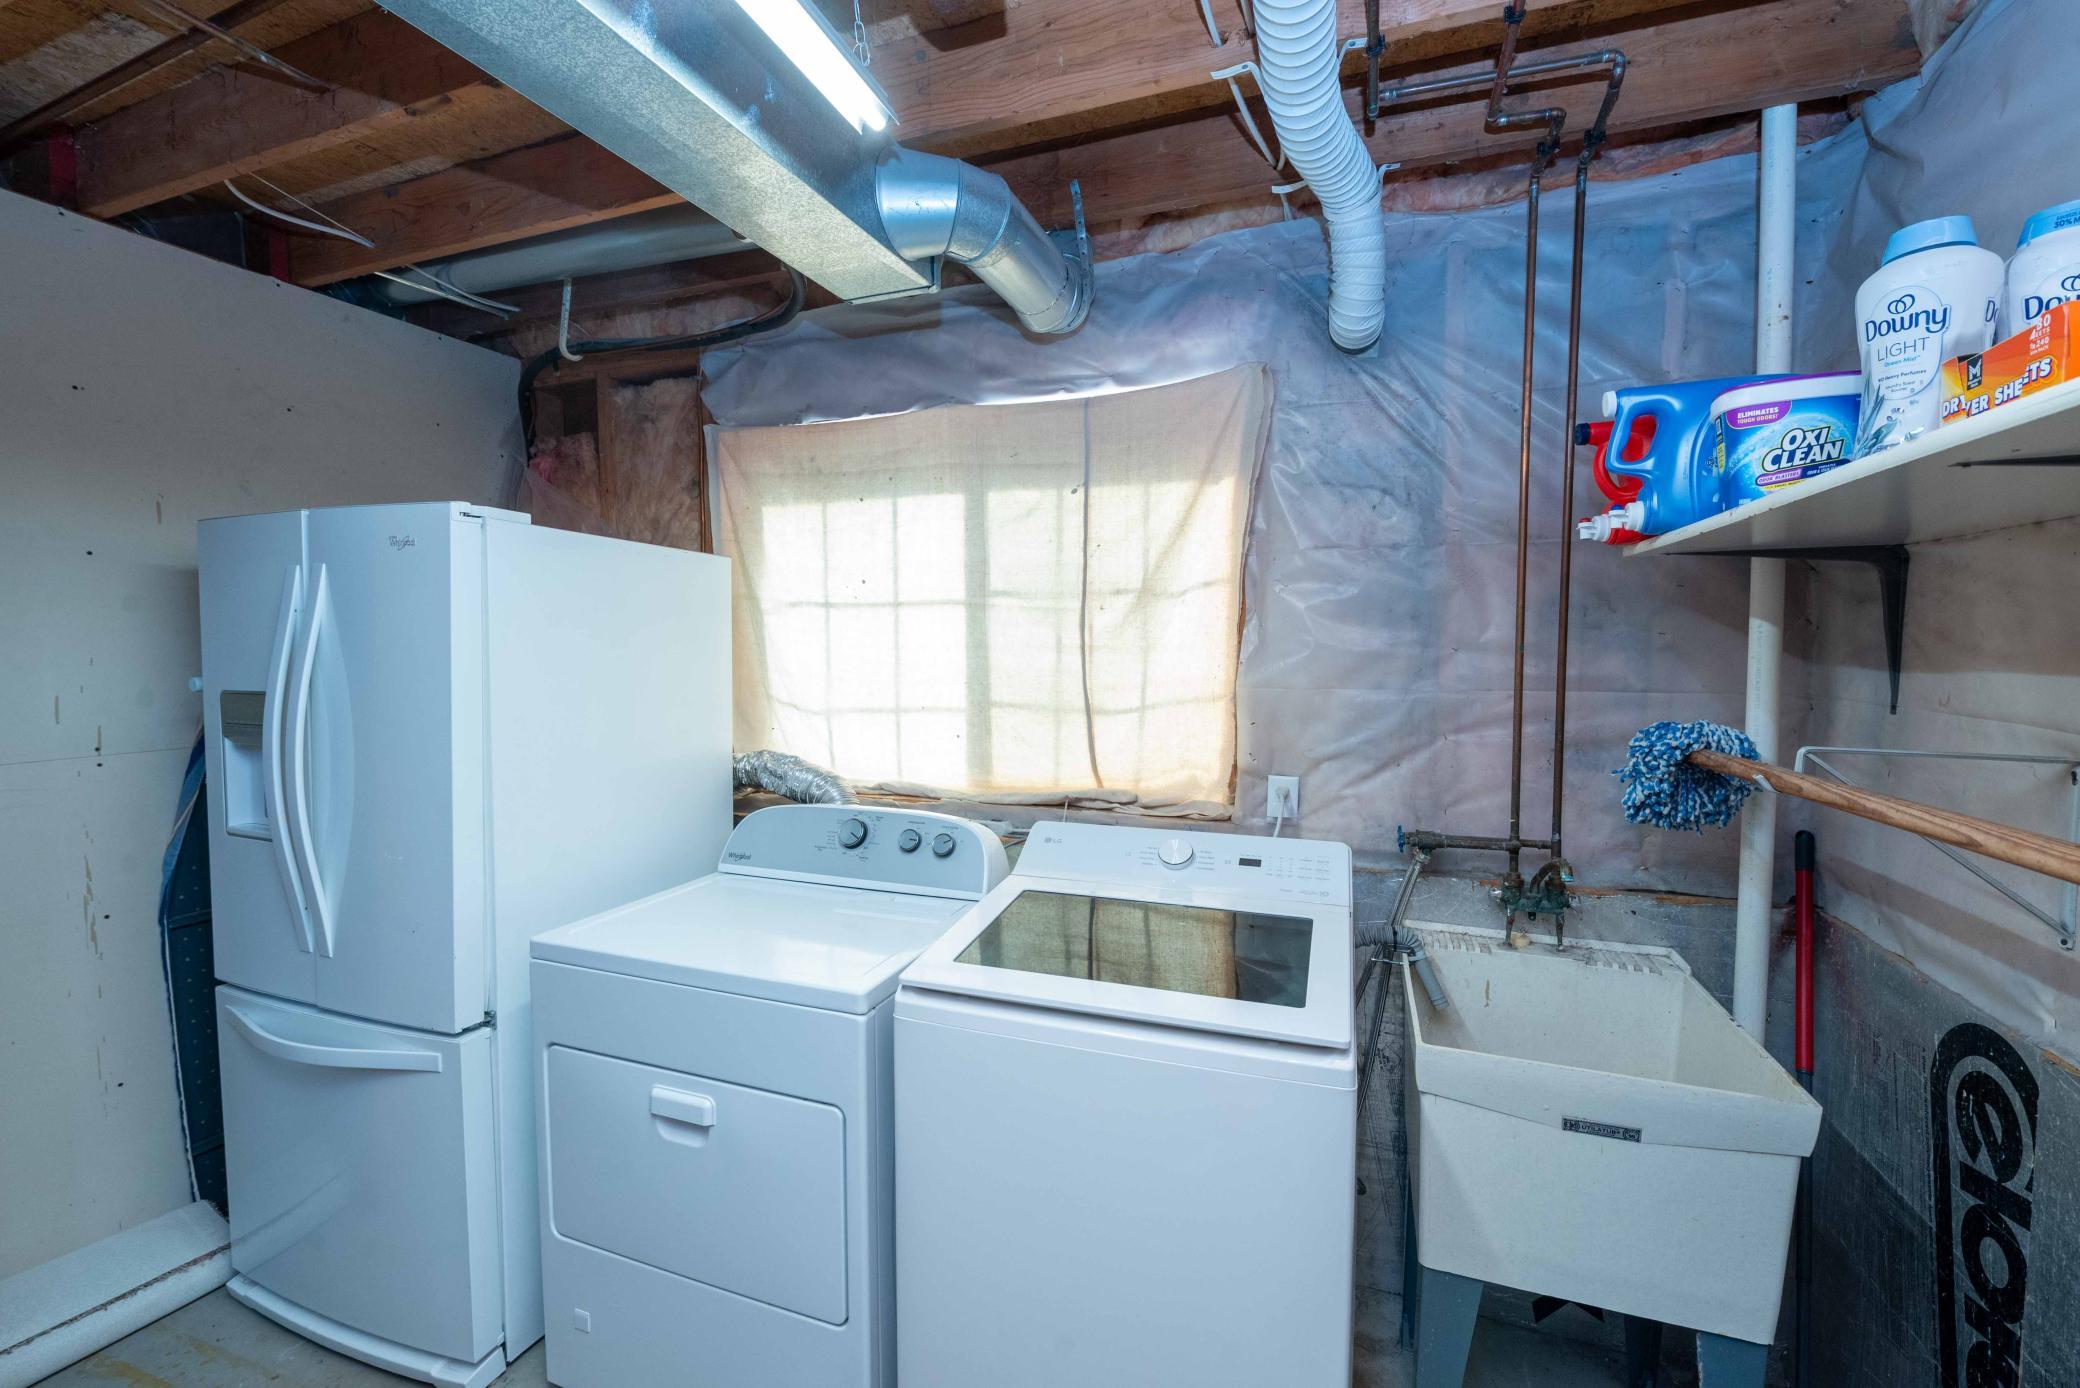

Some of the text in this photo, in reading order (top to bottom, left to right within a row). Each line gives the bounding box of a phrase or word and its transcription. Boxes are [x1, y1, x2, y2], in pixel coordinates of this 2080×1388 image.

[1865, 306, 1948, 342] Downy
[1877, 336, 1930, 361] LIGHT
[1900, 369, 1927, 377] Perfumes
[1994, 357, 2053, 406] SHEETS
[1737, 406, 1779, 419] ELIMINATES
[1756, 413, 1778, 422] ODORS!
[1781, 426, 1830, 450] OXI
[1762, 439, 1844, 472] CLEAN
[1759, 476, 1773, 484] ODOR
[1774, 471, 1800, 480] BLASTERS
[389, 535, 416, 551] Whirlpool
[728, 851, 752, 863] Whirlpool
